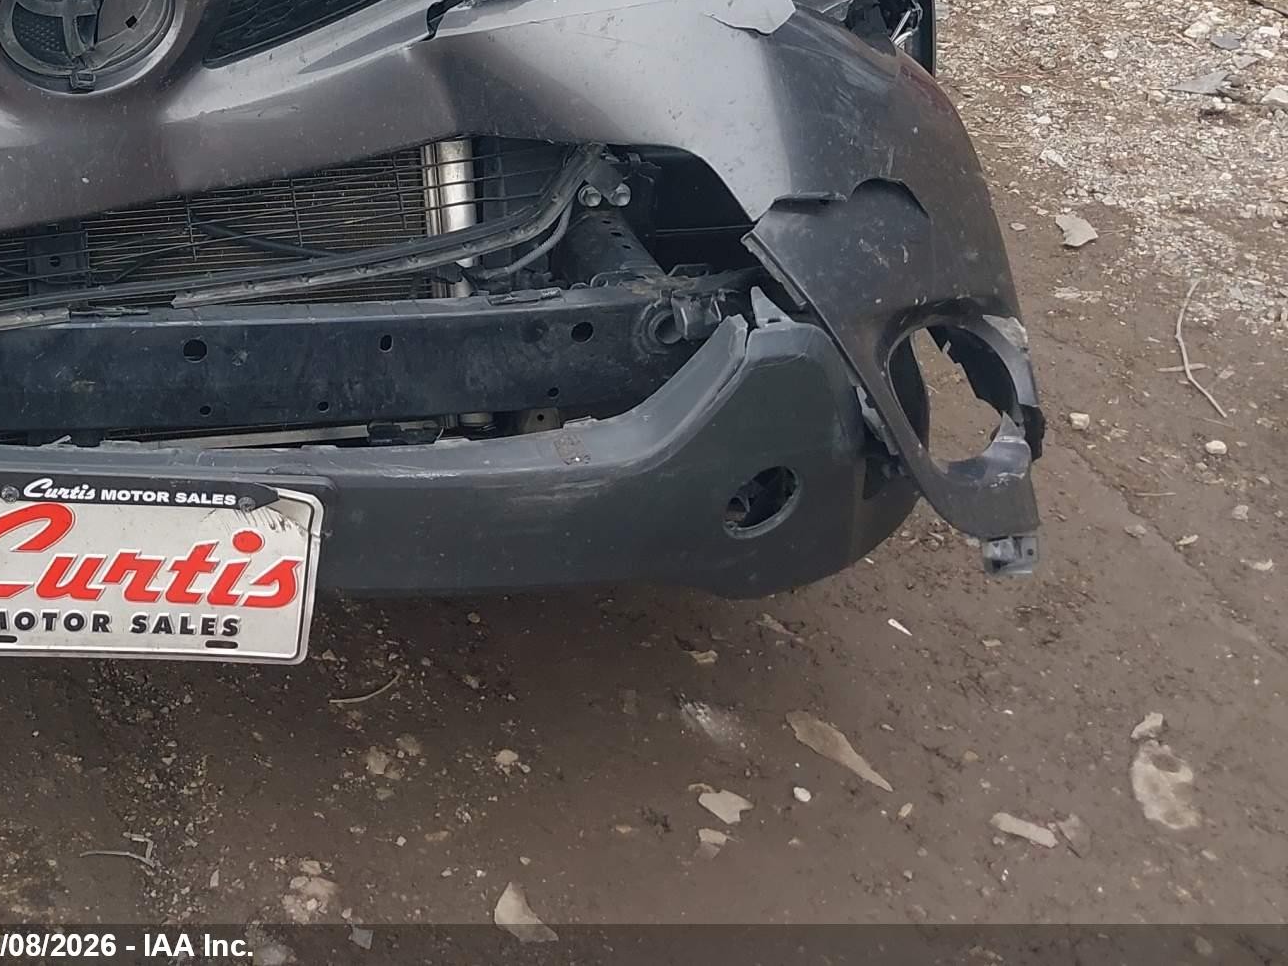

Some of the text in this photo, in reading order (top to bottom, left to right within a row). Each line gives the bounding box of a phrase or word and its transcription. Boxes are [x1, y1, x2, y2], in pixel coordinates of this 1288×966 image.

[24, 479, 237, 506] Curtis MOTOR SALES
[130, 614, 241, 636] SALES
